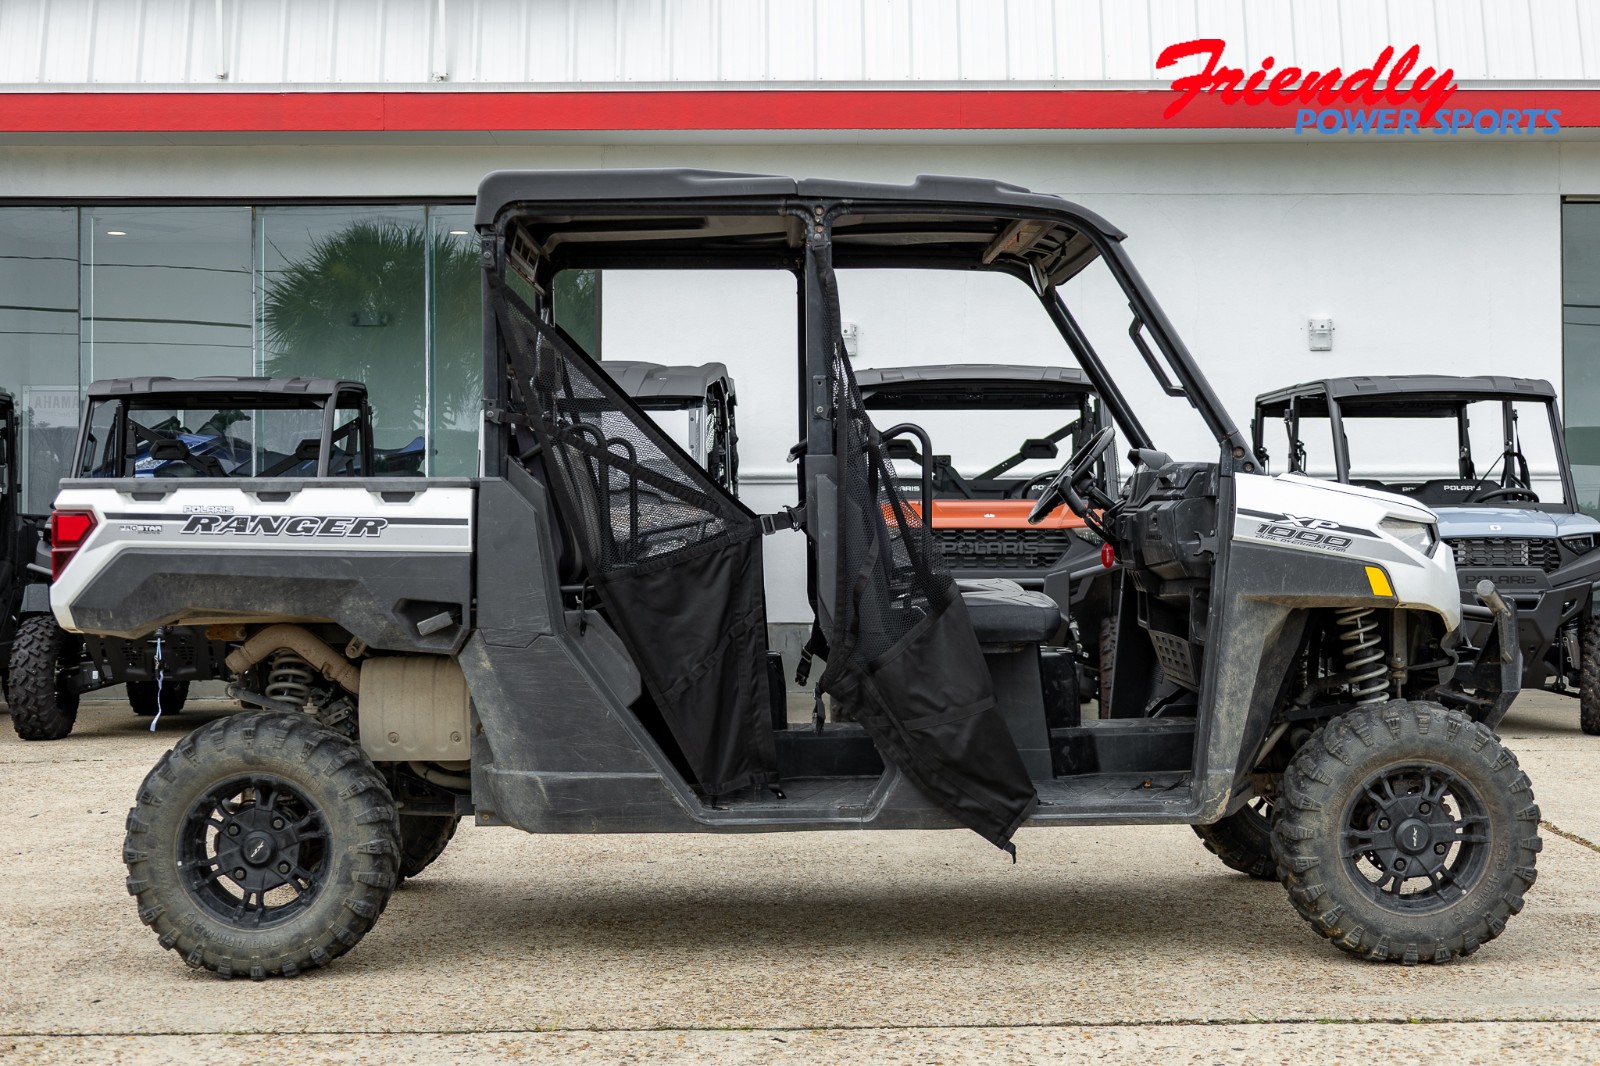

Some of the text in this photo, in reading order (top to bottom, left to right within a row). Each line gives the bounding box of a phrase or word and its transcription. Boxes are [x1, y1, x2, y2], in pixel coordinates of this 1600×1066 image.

[183, 505, 235, 515] POLARIS
[179, 514, 387, 537] RANGER
[1272, 513, 1340, 530] XP
[1255, 523, 1353, 549] 1000
[941, 541, 1039, 555] POLARIS
